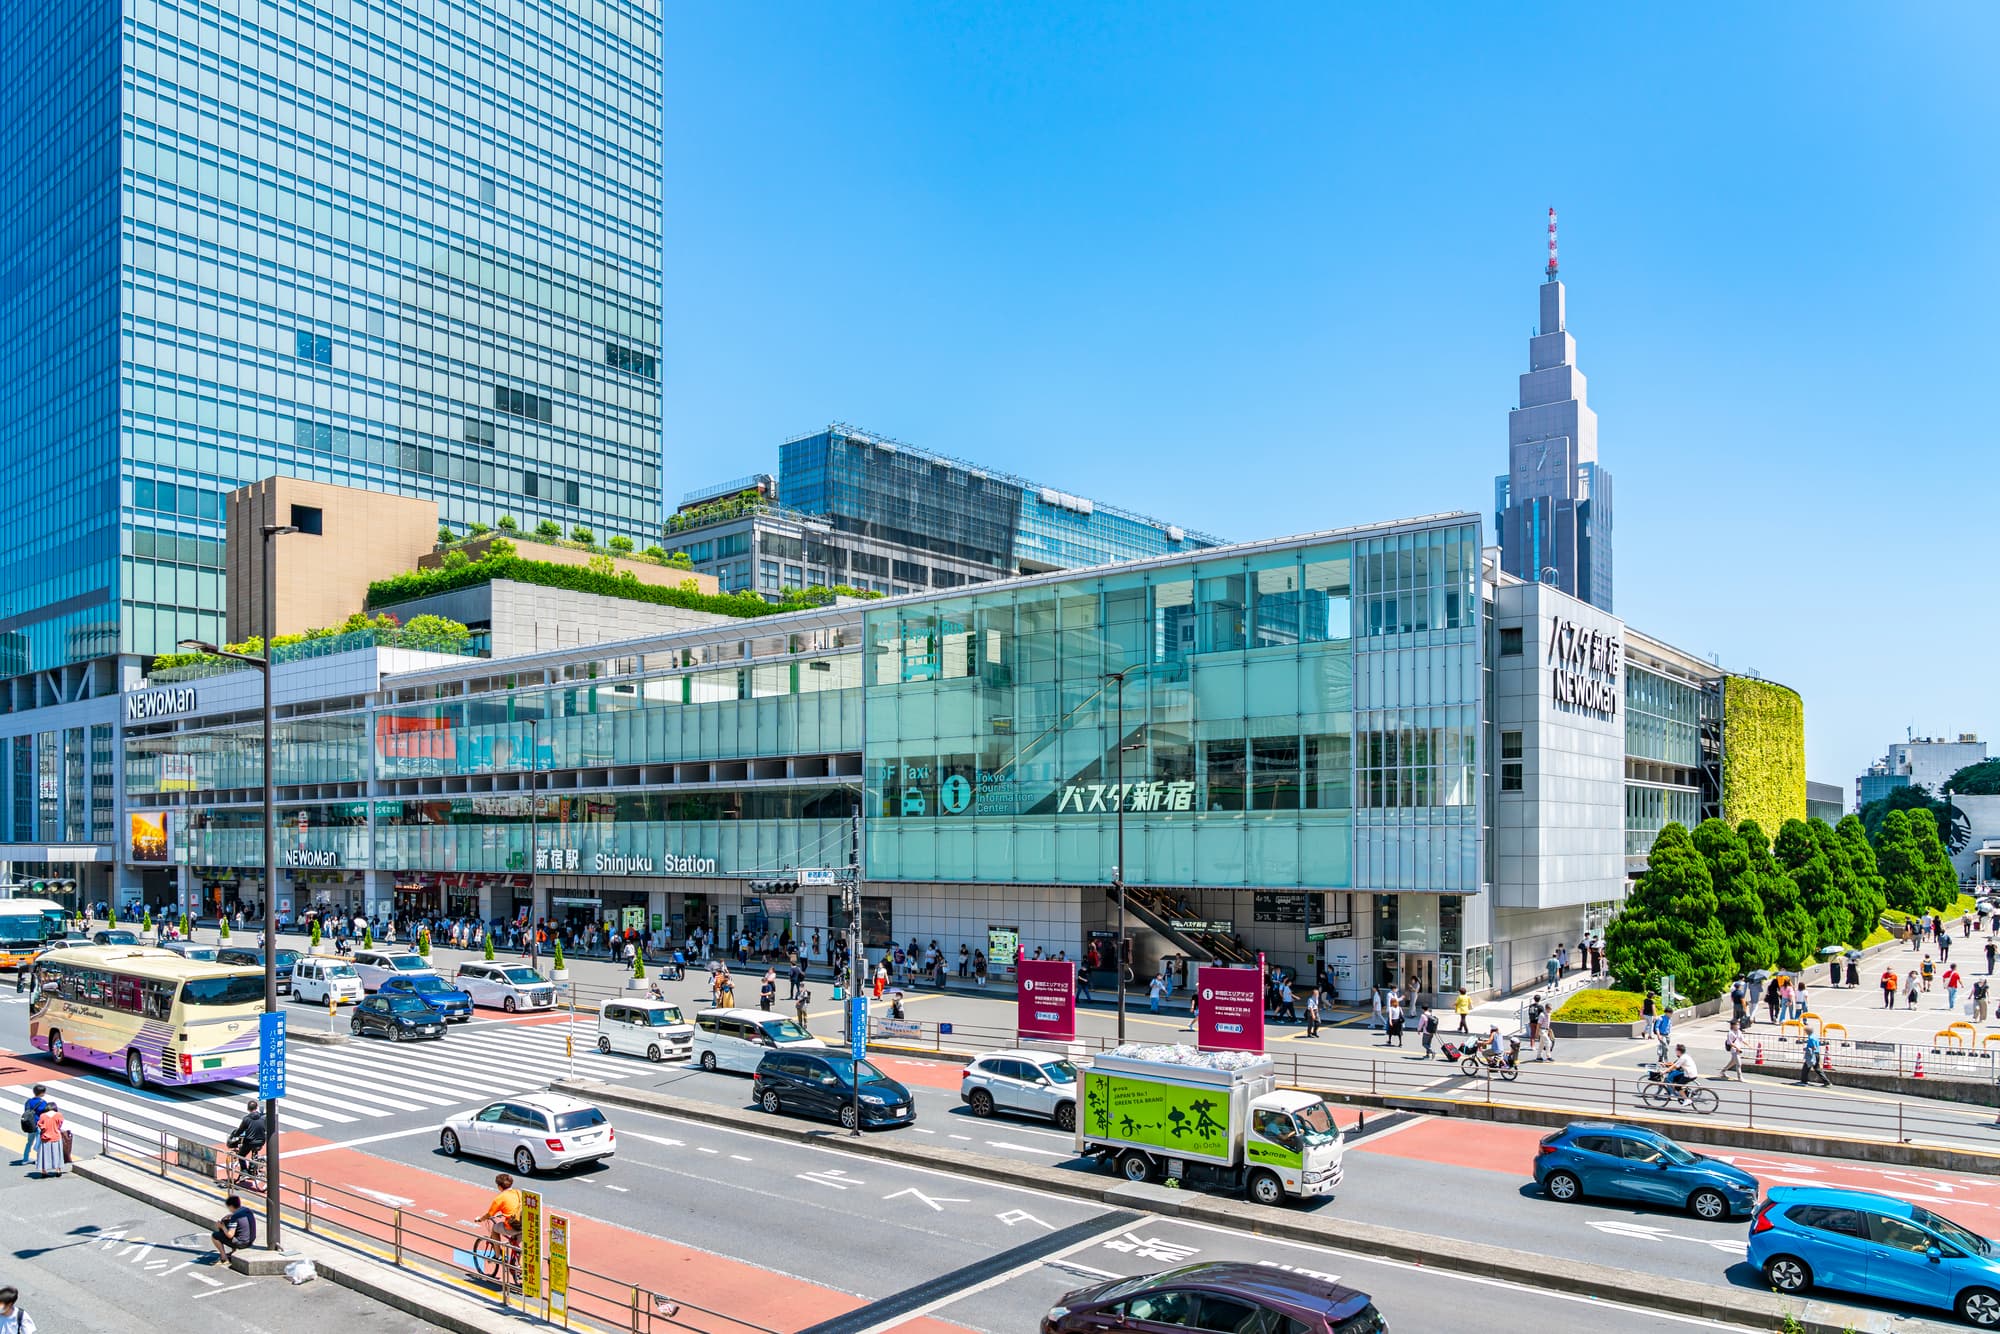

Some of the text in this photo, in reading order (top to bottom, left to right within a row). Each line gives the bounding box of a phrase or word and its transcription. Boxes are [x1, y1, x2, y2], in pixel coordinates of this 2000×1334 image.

[1548, 616, 1620, 676] バスタ新宿
[1553, 668, 1616, 714] NEWoMan
[128, 687, 196, 719] NEWoMan
[903, 764, 929, 780] Taxi
[977, 773, 1005, 782] Tokyo
[977, 783, 1010, 793] Tourist
[1057, 779, 1195, 813] バスタ新宿
[977, 792, 1033, 802] Information
[977, 803, 1009, 813] Center
[285, 849, 337, 866] NEWoMan
[505, 851, 523, 869] JR
[536, 848, 716, 875] 新宿駅 Shinjuku Station
